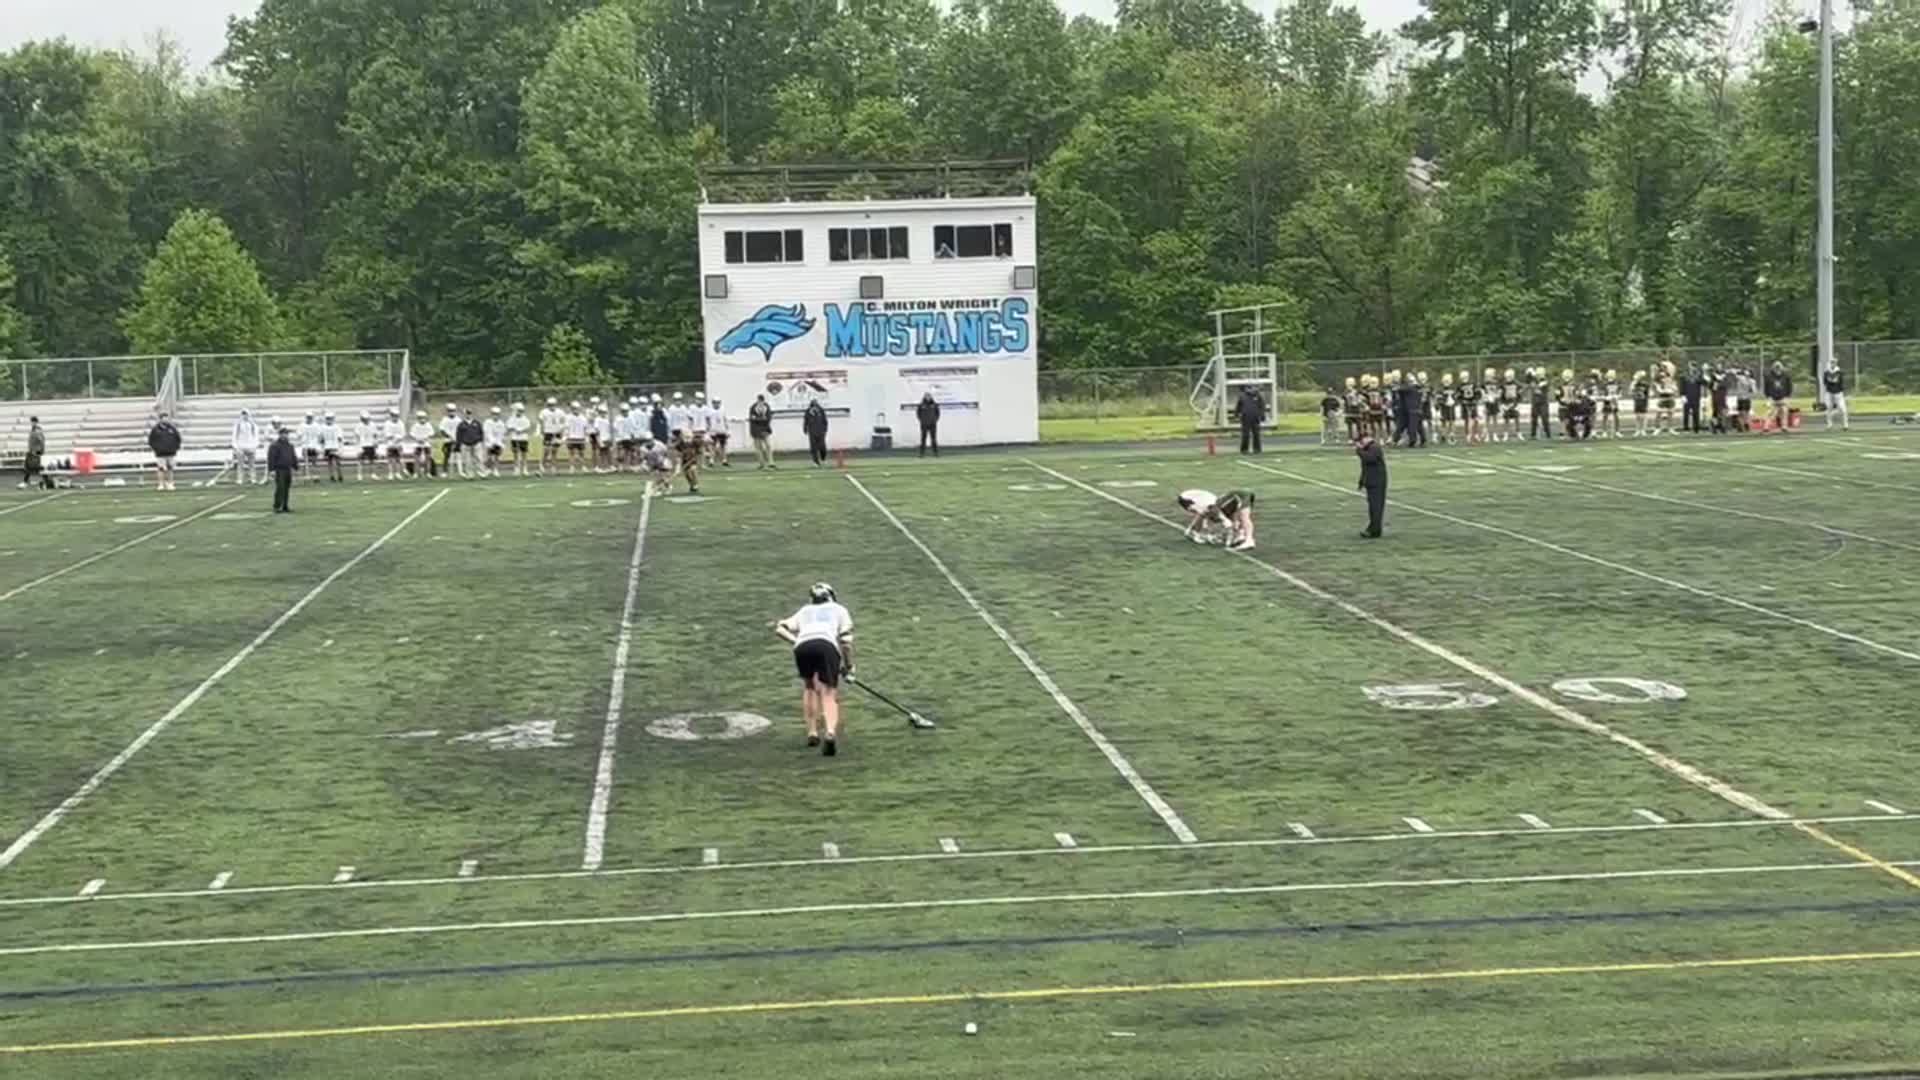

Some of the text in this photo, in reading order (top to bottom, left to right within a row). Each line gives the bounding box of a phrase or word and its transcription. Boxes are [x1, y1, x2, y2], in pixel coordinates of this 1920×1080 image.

[867, 298, 1000, 311] C. MILTON WRIGHT
[824, 298, 1029, 357] MUSTANGS
